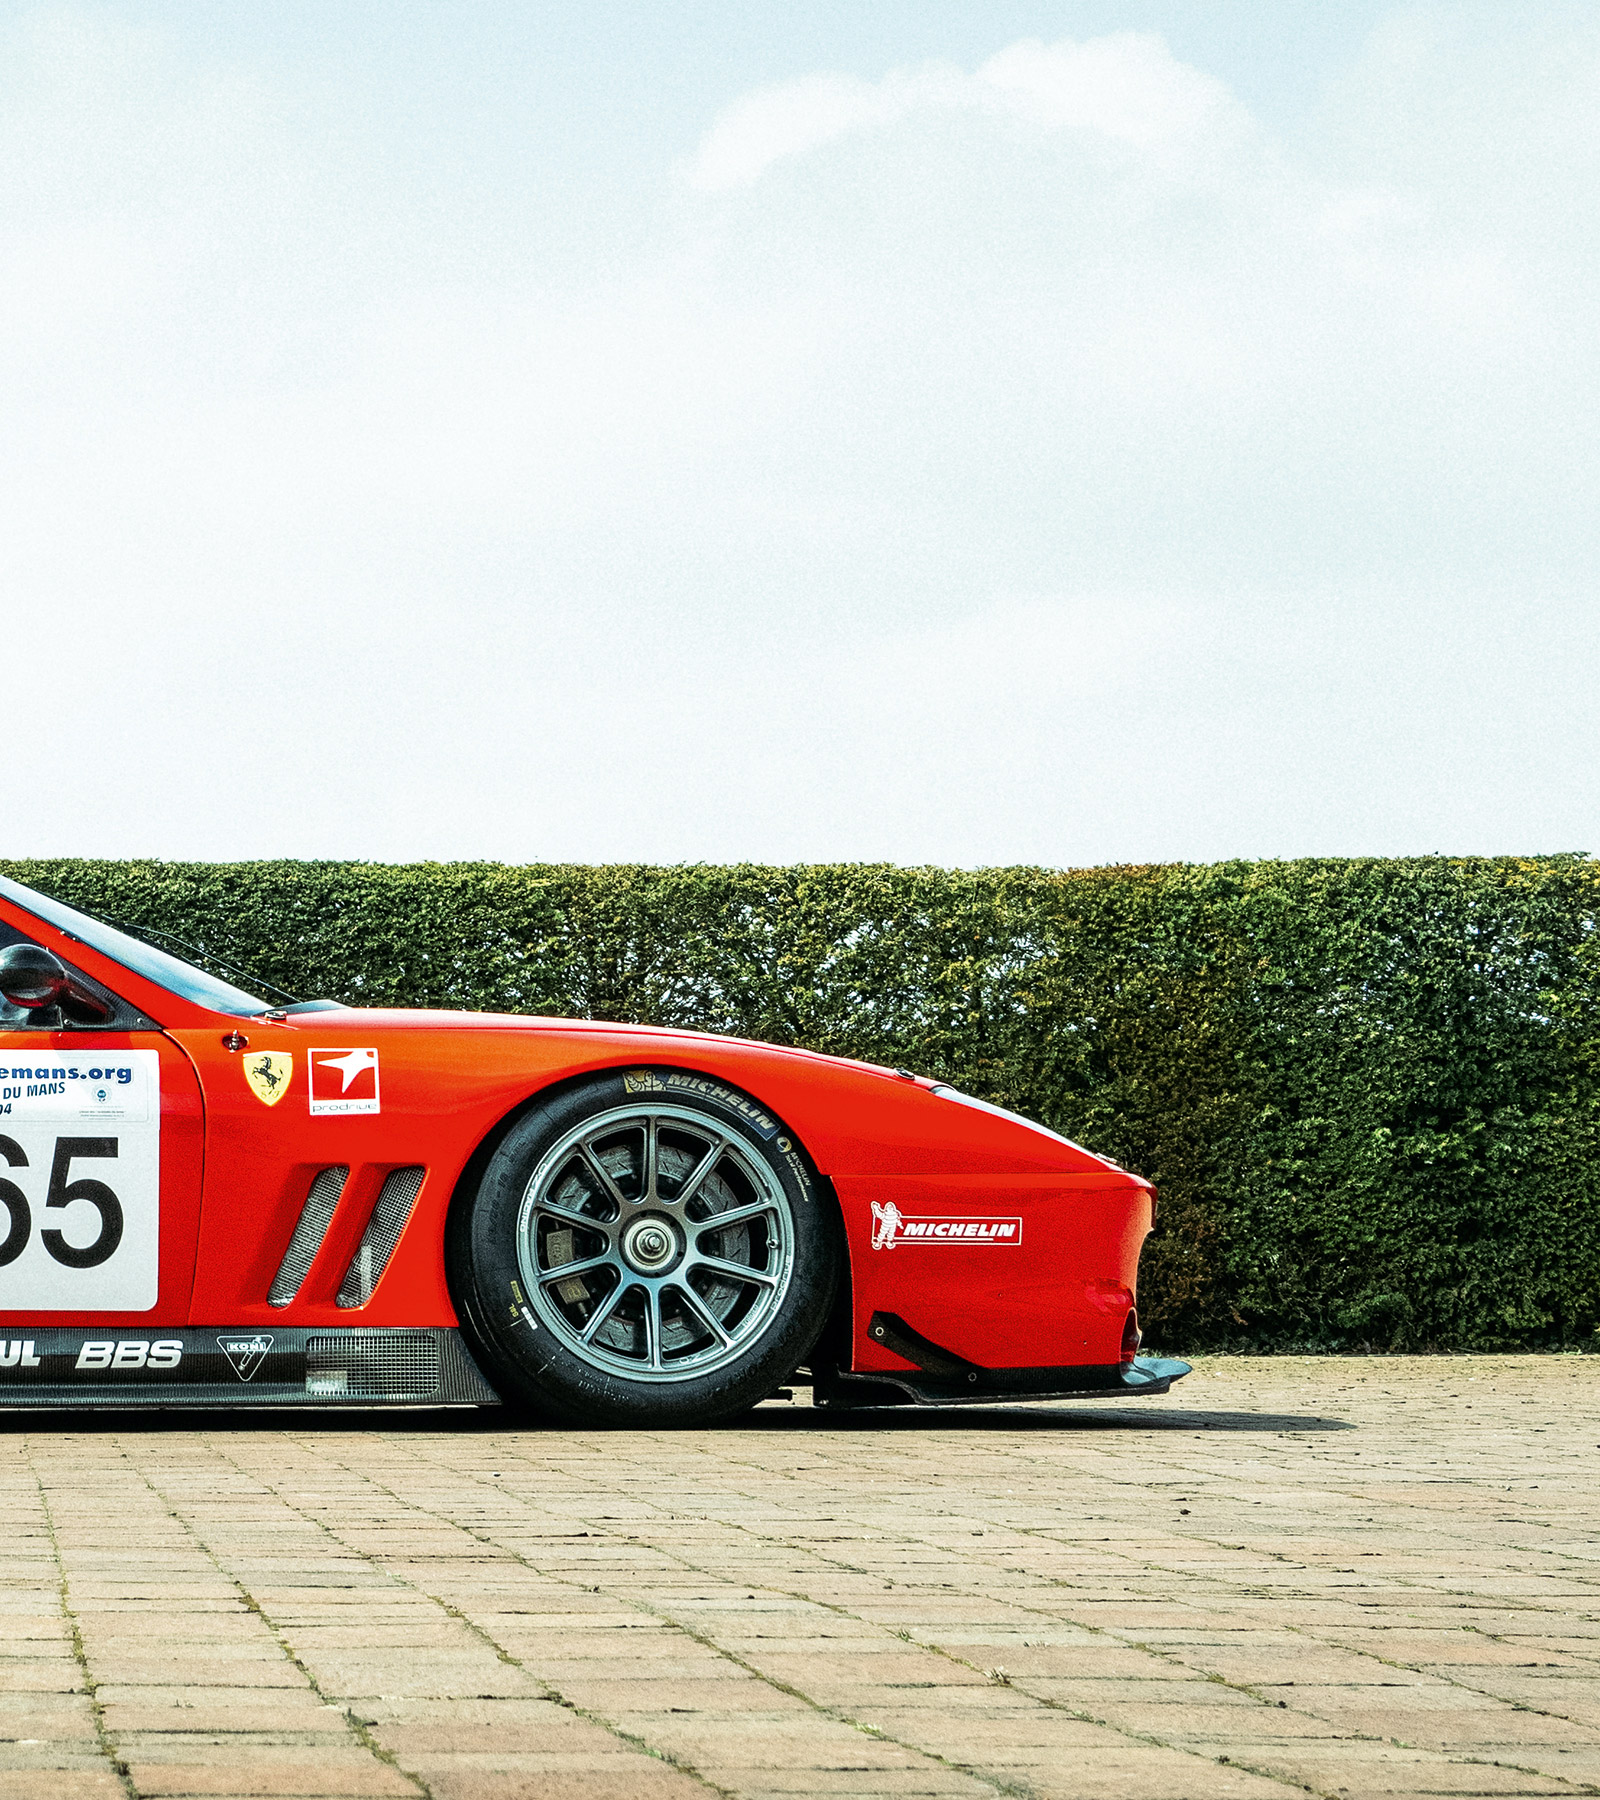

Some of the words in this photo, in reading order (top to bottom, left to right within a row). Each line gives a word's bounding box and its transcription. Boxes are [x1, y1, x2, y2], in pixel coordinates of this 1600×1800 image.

[2, 1085, 22, 1100] DU
[26, 1081, 67, 1098] MANS
[312, 1102, 378, 1113] prodrive
[666, 1073, 777, 1131] MICHELIN
[902, 1222, 1016, 1238] MICHELIN
[74, 1340, 184, 1369] BBS
[229, 1342, 265, 1350] KONI
